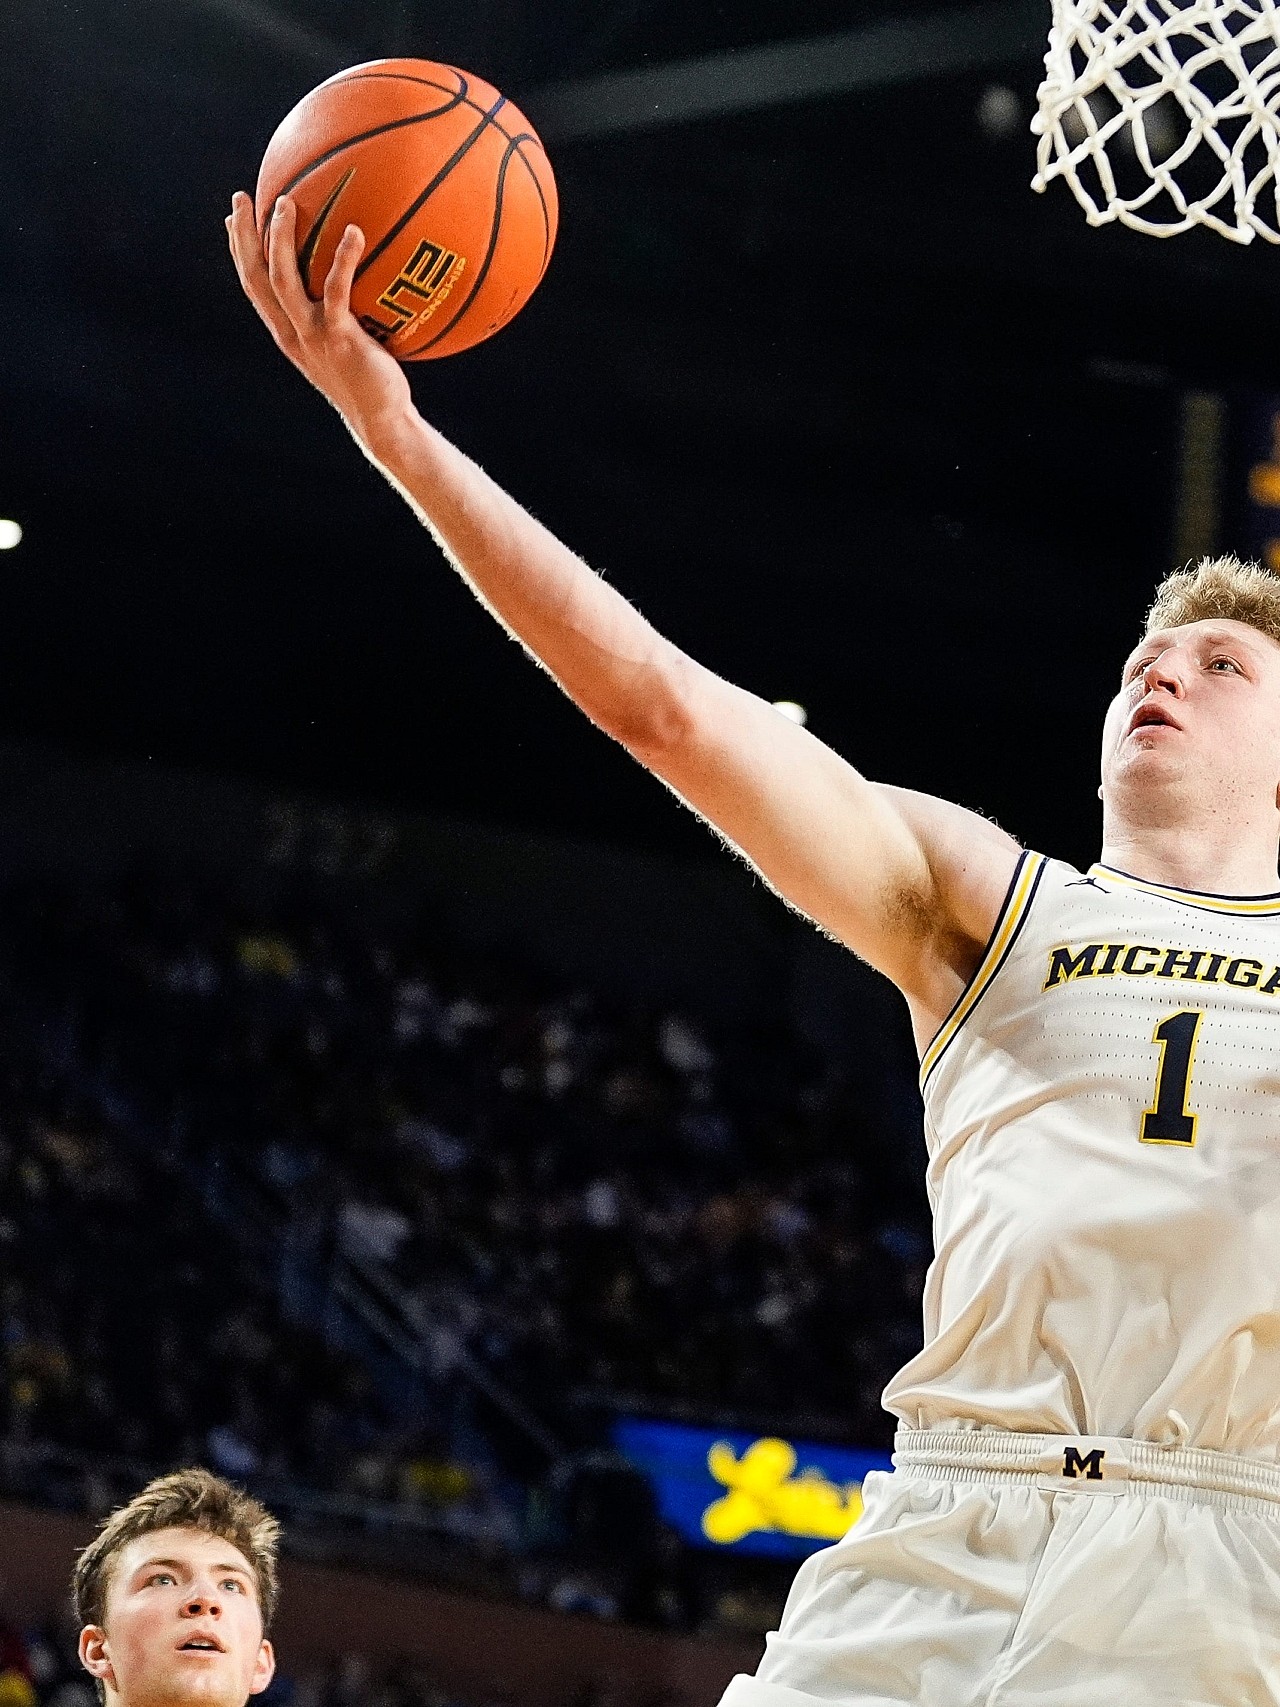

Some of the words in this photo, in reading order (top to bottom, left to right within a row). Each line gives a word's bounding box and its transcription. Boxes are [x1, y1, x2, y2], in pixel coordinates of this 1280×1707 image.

[358, 237, 459, 344] LITE
[1138, 1009, 1205, 1147] 1
[1062, 1446, 1106, 1480] M
